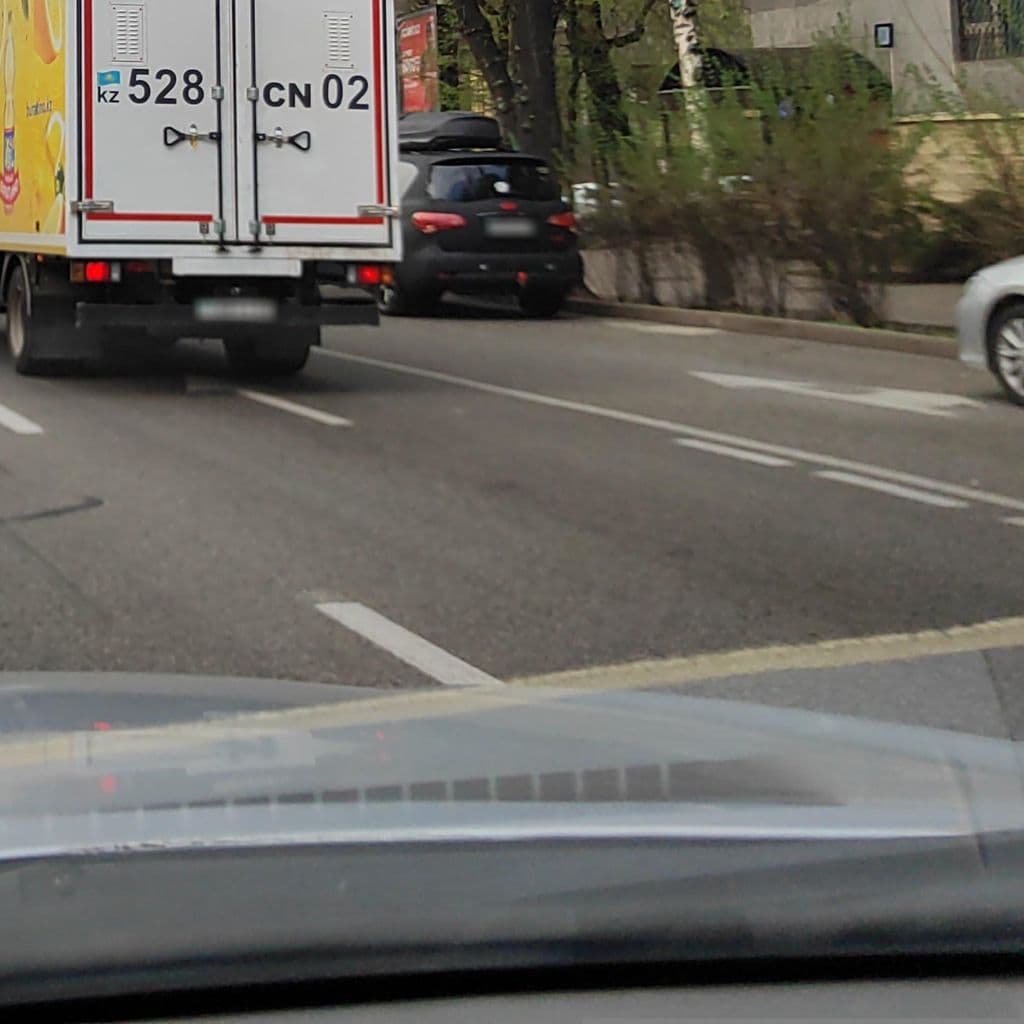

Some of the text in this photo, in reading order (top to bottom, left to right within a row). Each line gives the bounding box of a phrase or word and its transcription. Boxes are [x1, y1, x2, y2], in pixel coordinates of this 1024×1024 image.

[128, 68, 205, 105] 528
[263, 81, 312, 108] CN
[322, 73, 369, 110] 02
